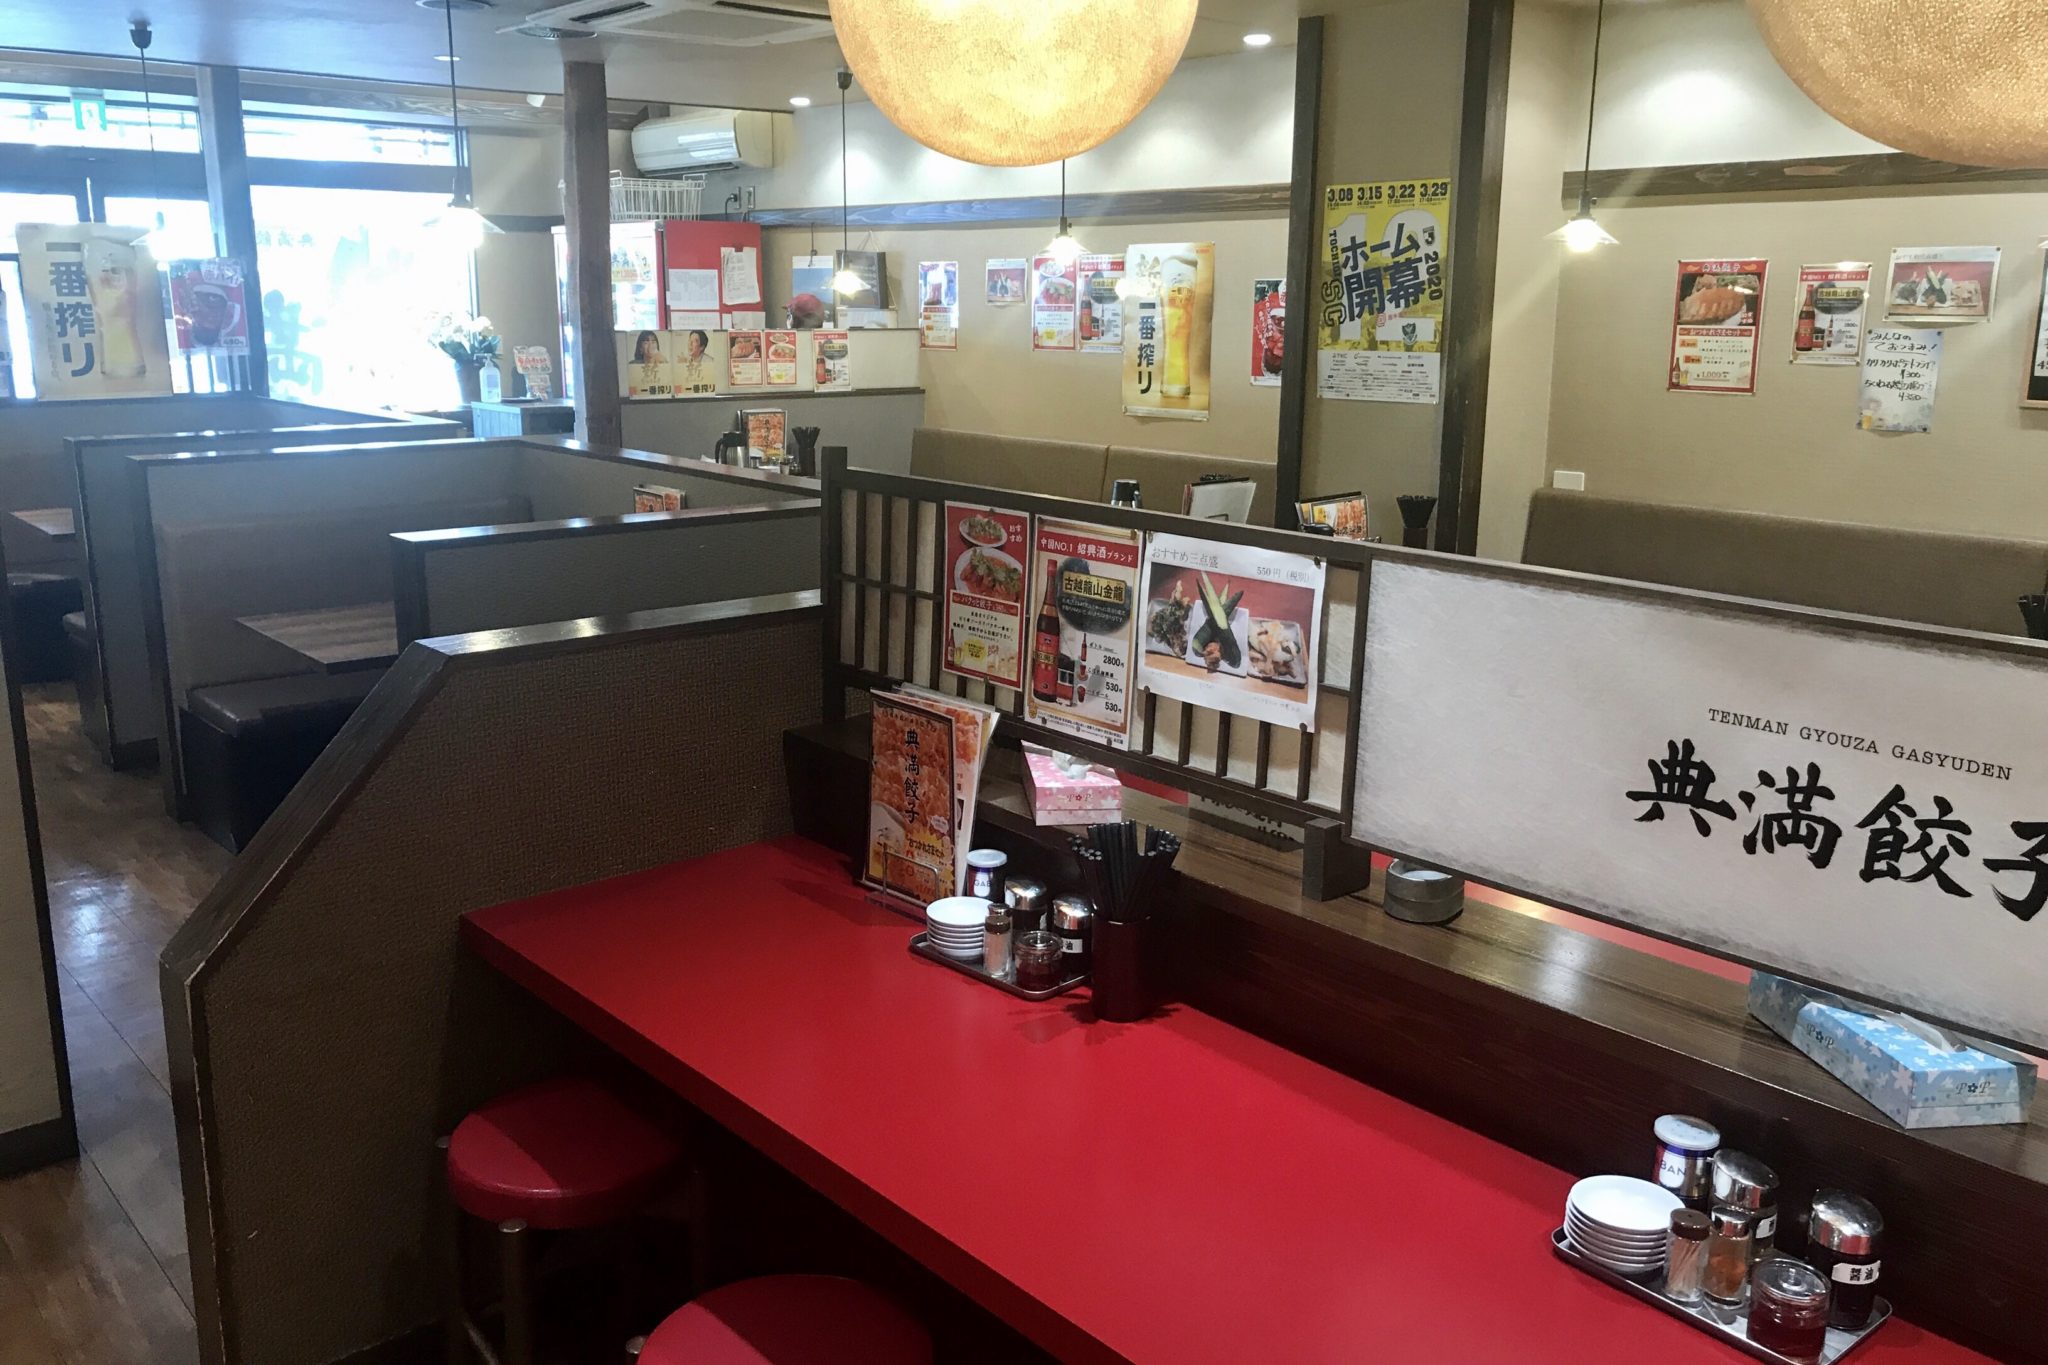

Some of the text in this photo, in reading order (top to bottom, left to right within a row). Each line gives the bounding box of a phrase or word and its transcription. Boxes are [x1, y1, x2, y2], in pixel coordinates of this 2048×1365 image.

[1327, 182, 1448, 202] 3.08 3.15 3.22 3.29
[1341, 223, 1421, 272] ホーム
[1344, 257, 1426, 322] 開幕
[1424, 251, 1443, 301] 2020
[45, 242, 96, 378] 一番搾り
[1321, 279, 1347, 328] SC
[1137, 302, 1156, 395] 一番搾り
[641, 384, 672, 394] 一番搾り
[685, 383, 716, 393] 一番搾り
[1041, 537, 1134, 562] 中国NO.1 紹興酒ブランド
[1152, 546, 1219, 569] おすすめ三点盛
[1064, 576, 1124, 602] 古越龍山金龍
[1708, 708, 2012, 781] TENMAN GYOUZA GASYUDEN
[904, 727, 920, 824] 典満餃子
[1625, 738, 2048, 922] 典満餃子
